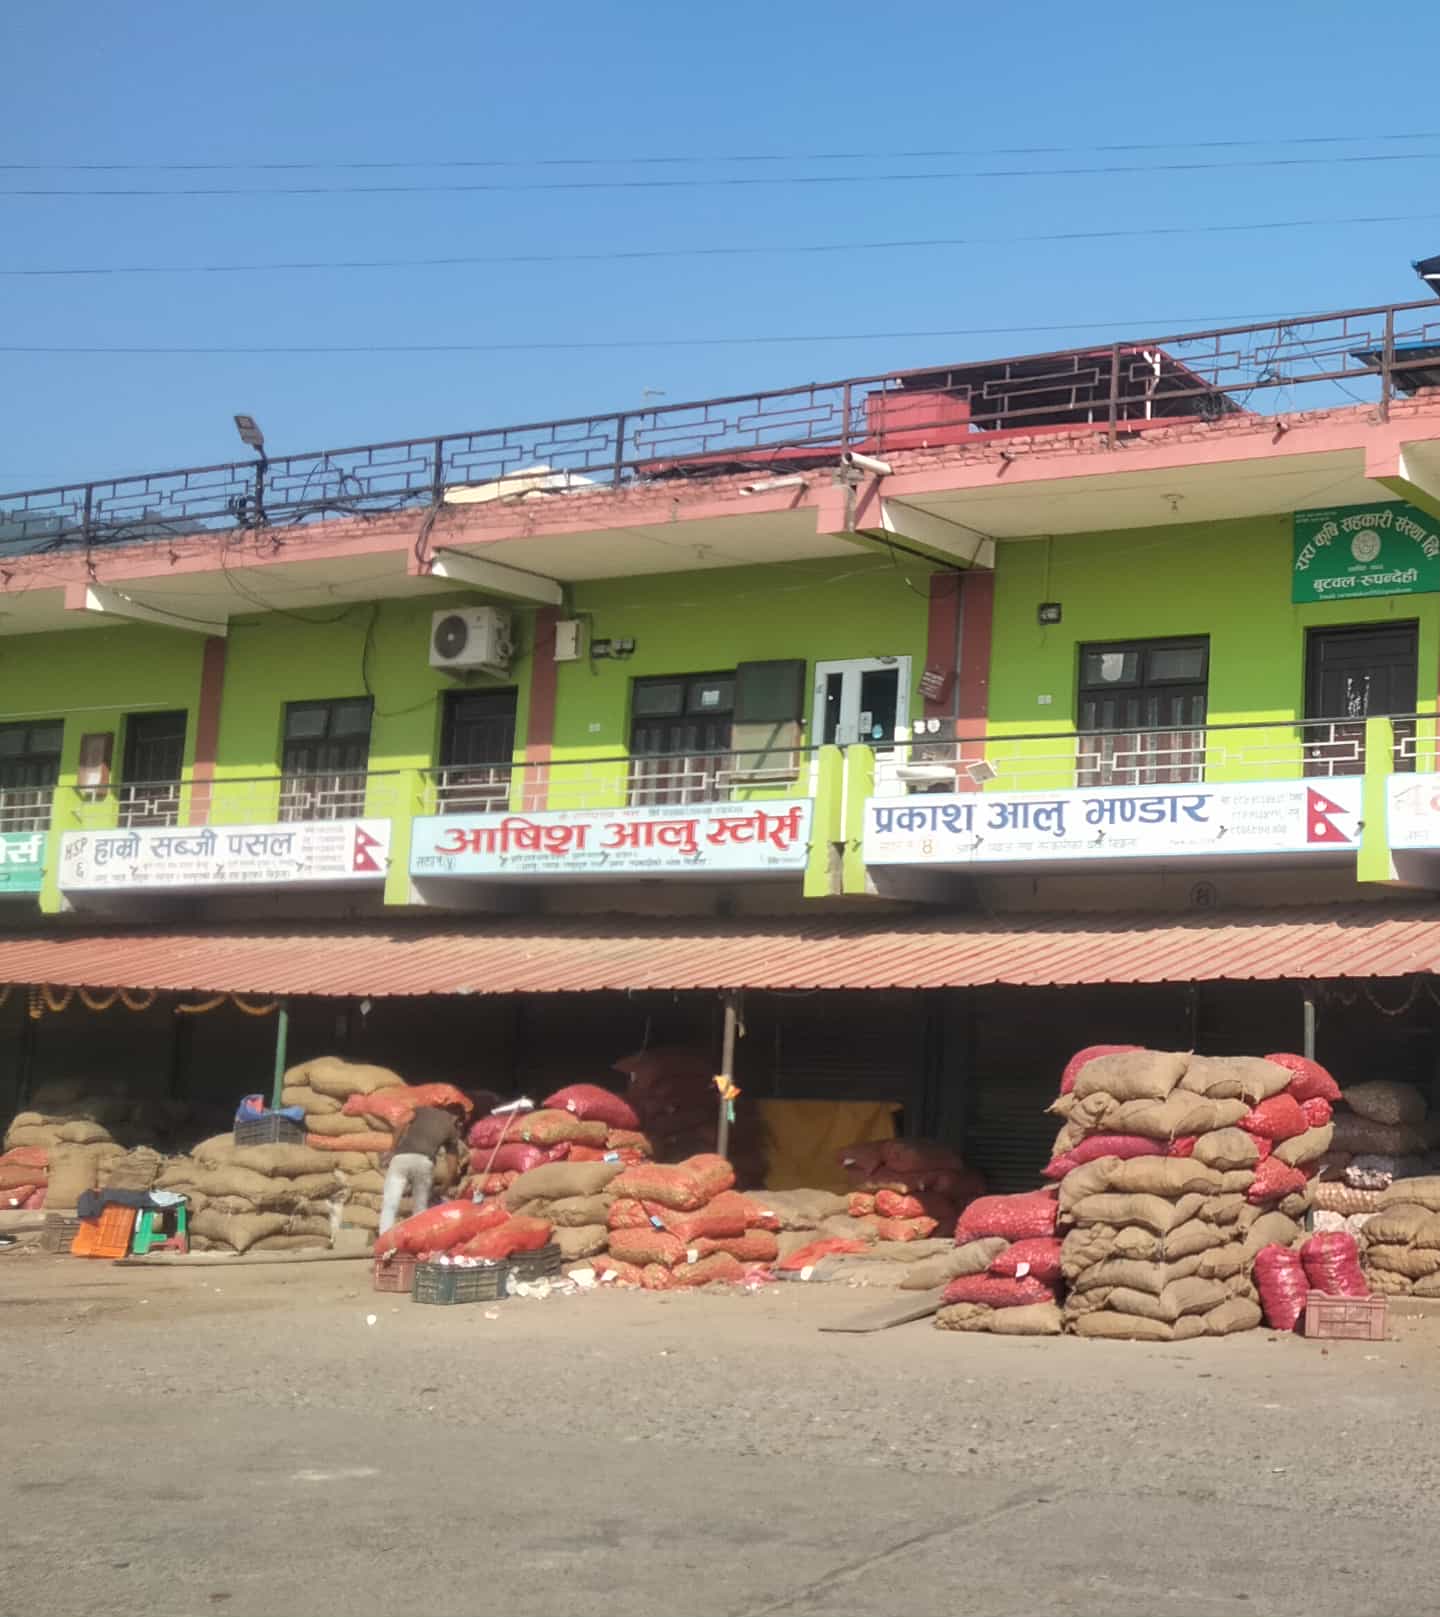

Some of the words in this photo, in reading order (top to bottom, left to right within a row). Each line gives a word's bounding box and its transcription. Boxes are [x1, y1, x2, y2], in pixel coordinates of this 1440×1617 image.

[1313, 521, 1339, 547] कृषि
[1340, 509, 1394, 533] सहकारी
[1395, 516, 1428, 543] संस्था
[600, 818, 702, 858] आलु
[704, 805, 804, 850] स्टोर्स
[871, 801, 979, 836] प्रकाश
[986, 798, 1073, 838] आलु
[1083, 793, 1216, 826] भण्डार
[94, 831, 142, 866] हाम्रो
[150, 828, 218, 857] सब्जी
[226, 832, 297, 856] पसल
